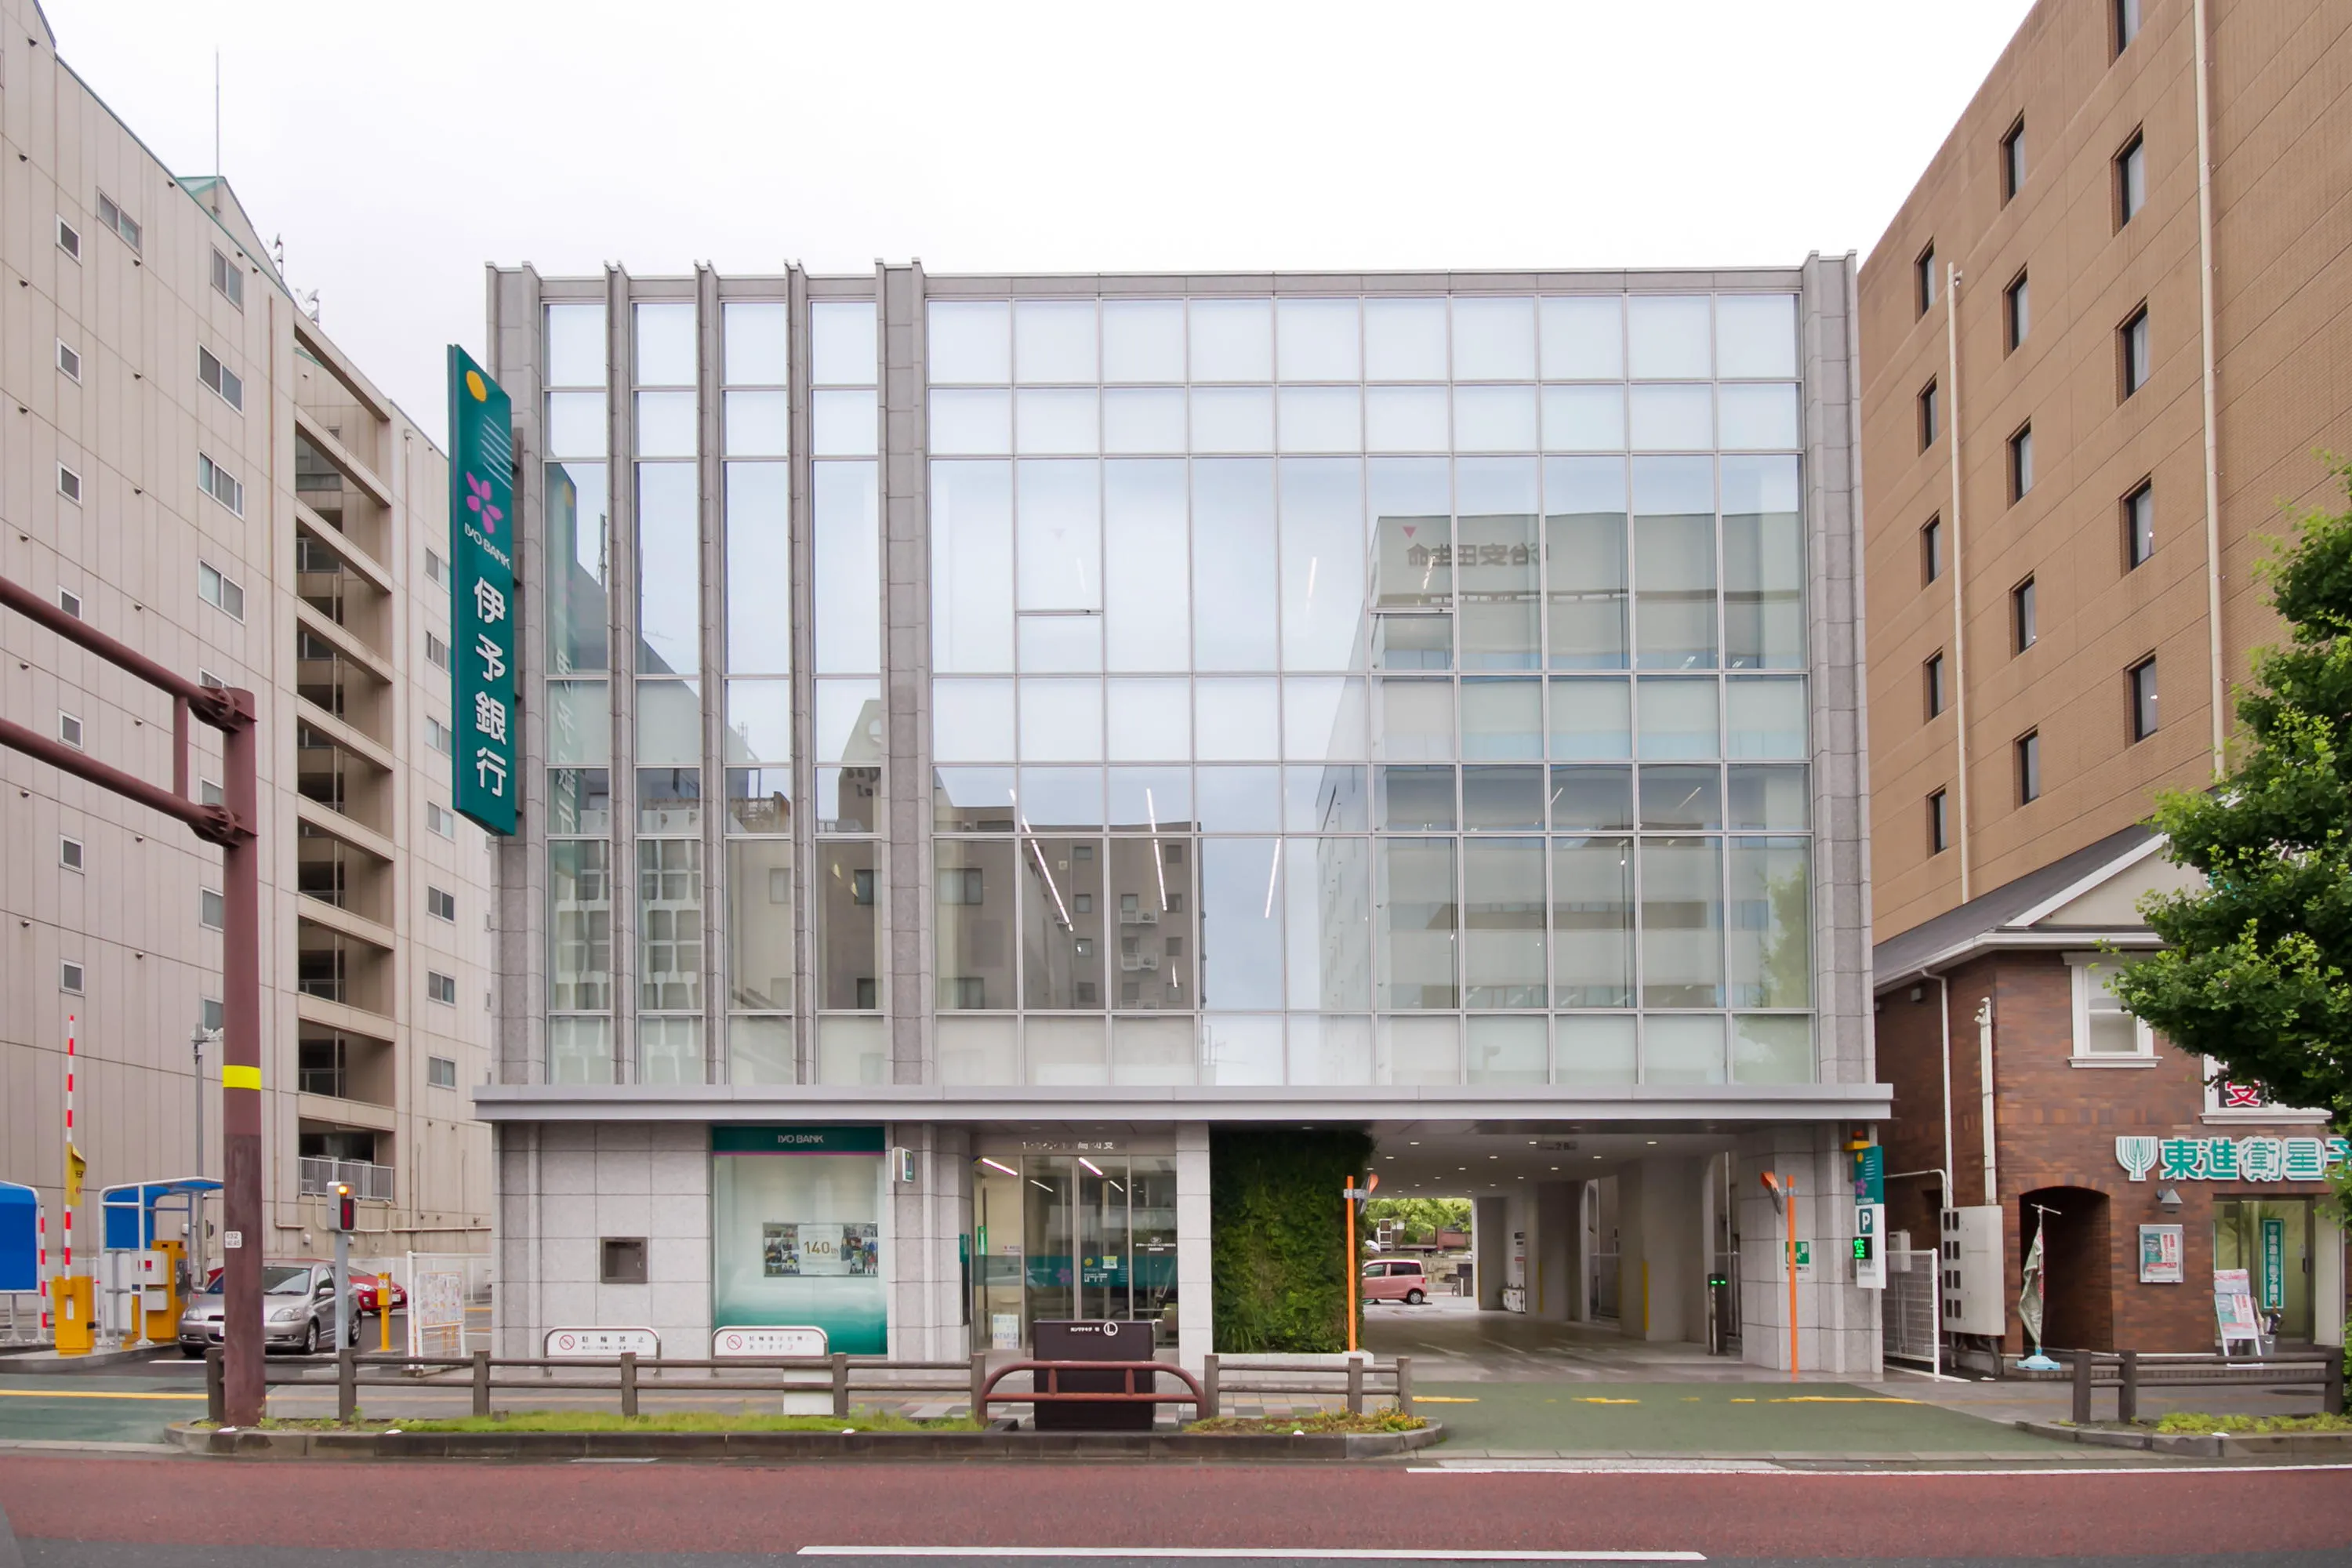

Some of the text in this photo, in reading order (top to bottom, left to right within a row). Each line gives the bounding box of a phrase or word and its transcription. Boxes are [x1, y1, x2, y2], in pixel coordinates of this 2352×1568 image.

[464, 521, 511, 570] IYO BANK
[474, 576, 506, 797] 伊予銀行
[777, 1134, 824, 1144] IYO BANK
[1862, 1212, 1871, 1231] P
[1853, 1238, 1865, 1258] 空
